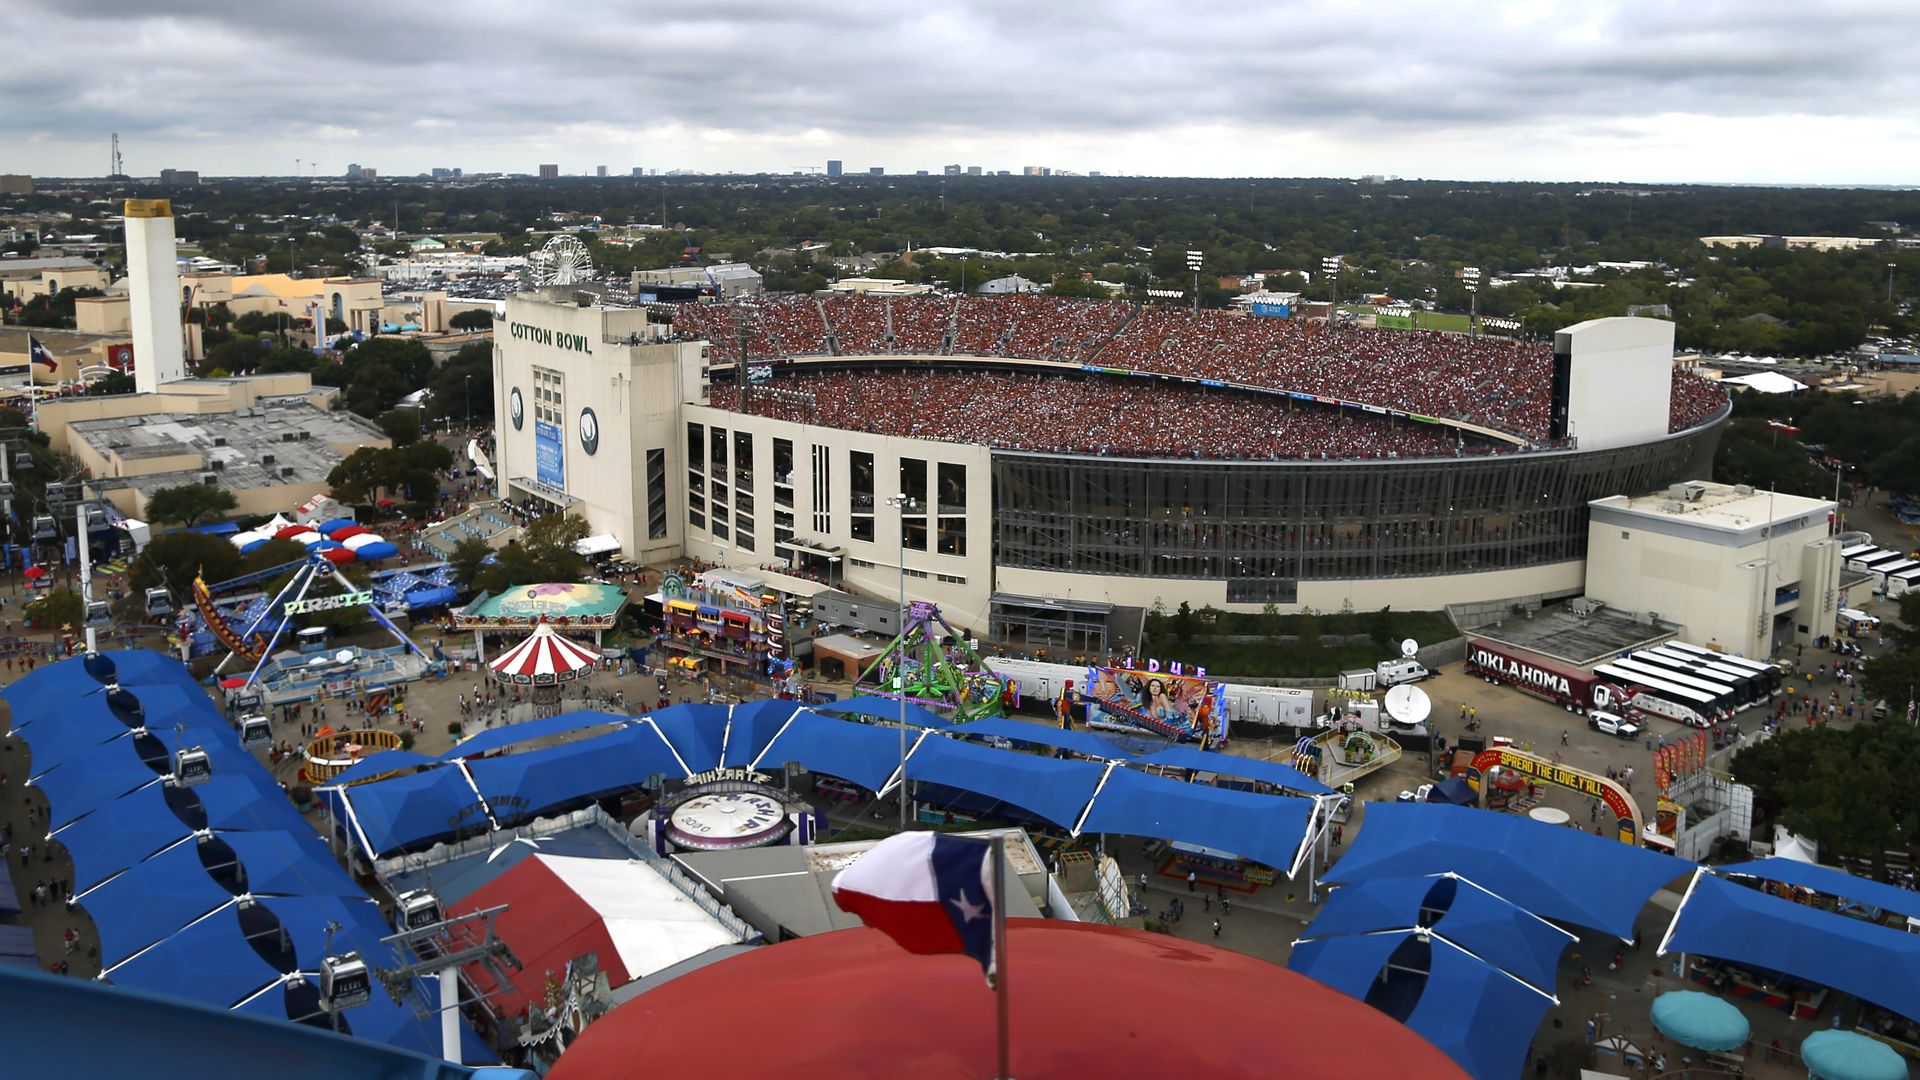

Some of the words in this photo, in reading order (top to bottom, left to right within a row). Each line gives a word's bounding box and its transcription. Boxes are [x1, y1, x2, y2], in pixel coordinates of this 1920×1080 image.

[511, 321, 552, 346] COTTON
[556, 331, 593, 355] BOWL
[284, 589, 373, 616] PIRATE
[1478, 650, 1571, 696] OKLAHOMA
[1329, 688, 1370, 700] STORM
[1501, 752, 1534, 773] SPREAD
[1535, 763, 1553, 780] THE
